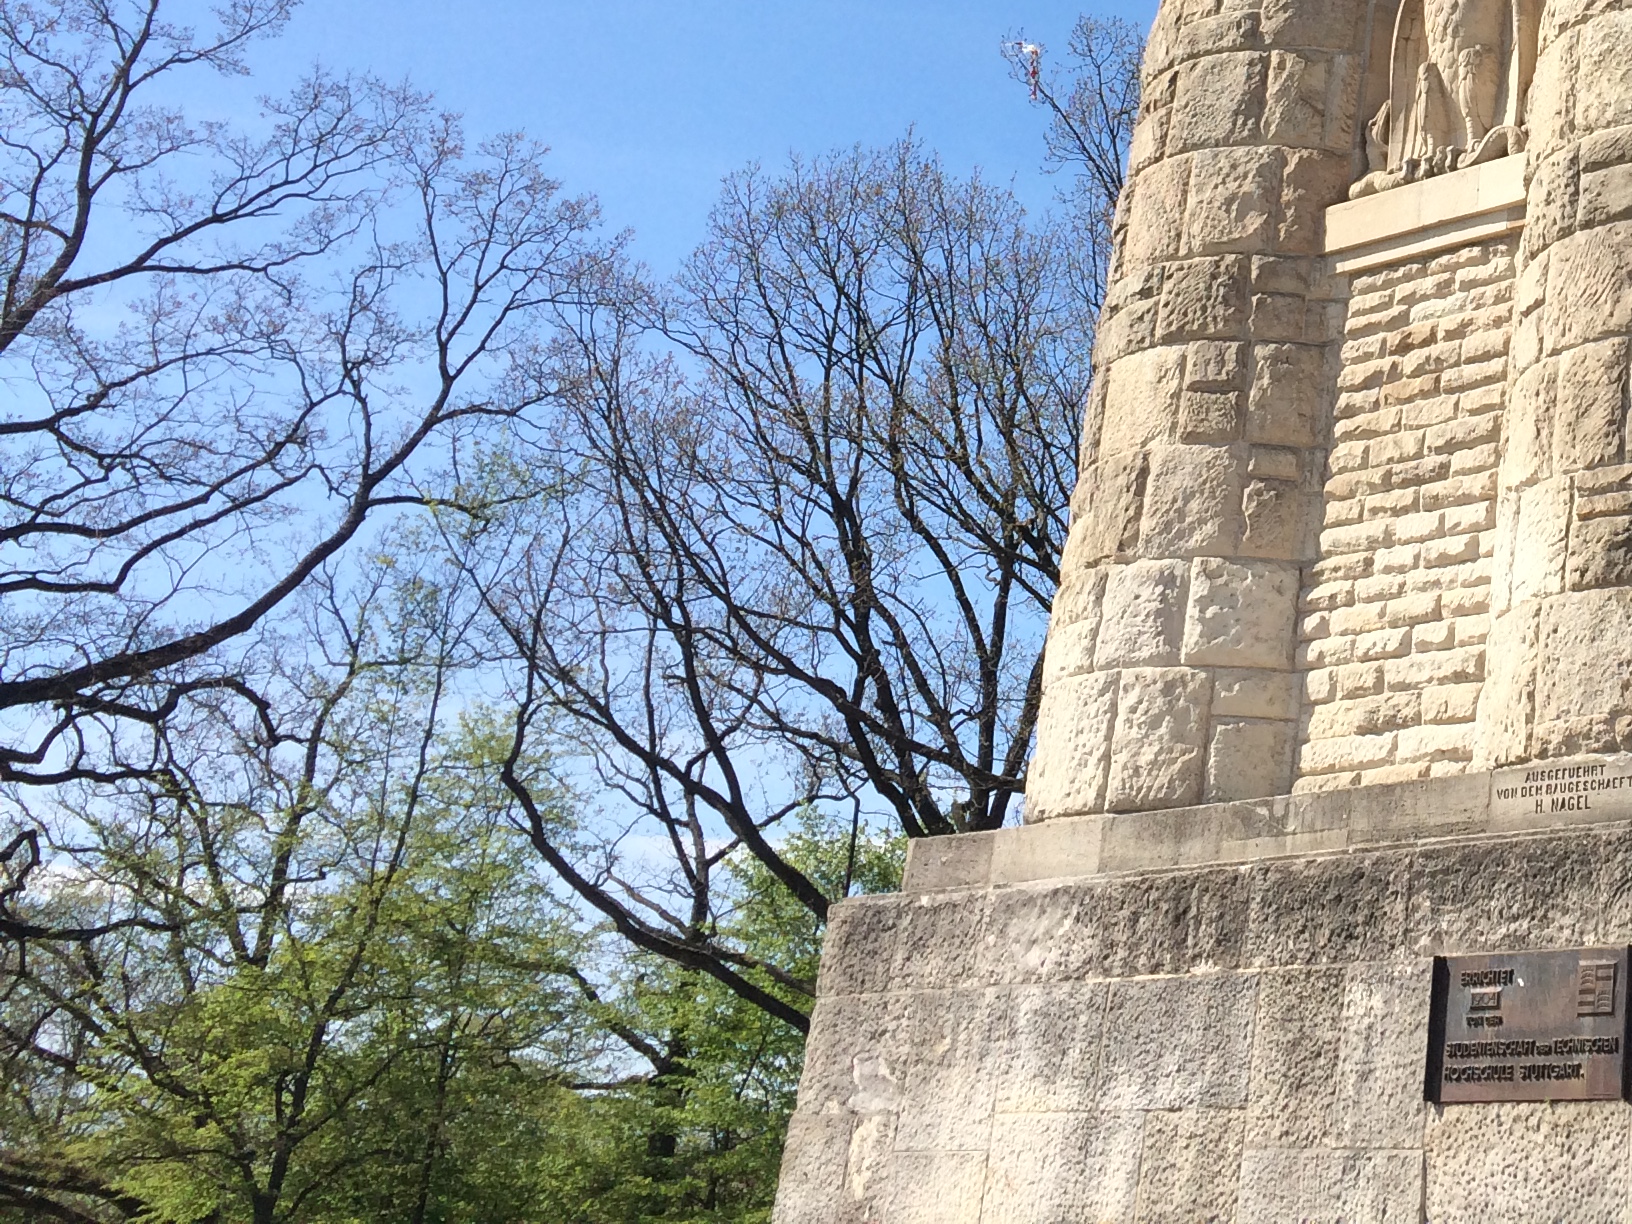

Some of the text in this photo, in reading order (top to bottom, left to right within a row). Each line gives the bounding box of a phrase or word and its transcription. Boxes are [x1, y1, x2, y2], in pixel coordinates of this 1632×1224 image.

[1525, 764, 1606, 783] AUSGEFUEHRT
[1496, 788, 1518, 800] VON
[1521, 785, 1542, 798] DEM
[1551, 795, 1591, 813] NAGEL
[1460, 969, 1515, 986] ERRICHTET
[1472, 993, 1497, 1006] 1904
[1466, 1015, 1503, 1027] VON DER
[1445, 1039, 1536, 1057] STUDENTENSCHAFT
[1552, 1037, 1619, 1056] TECHNISCHEN
[1444, 1063, 1585, 1082] HOCHSCHULE STUTTGART.
